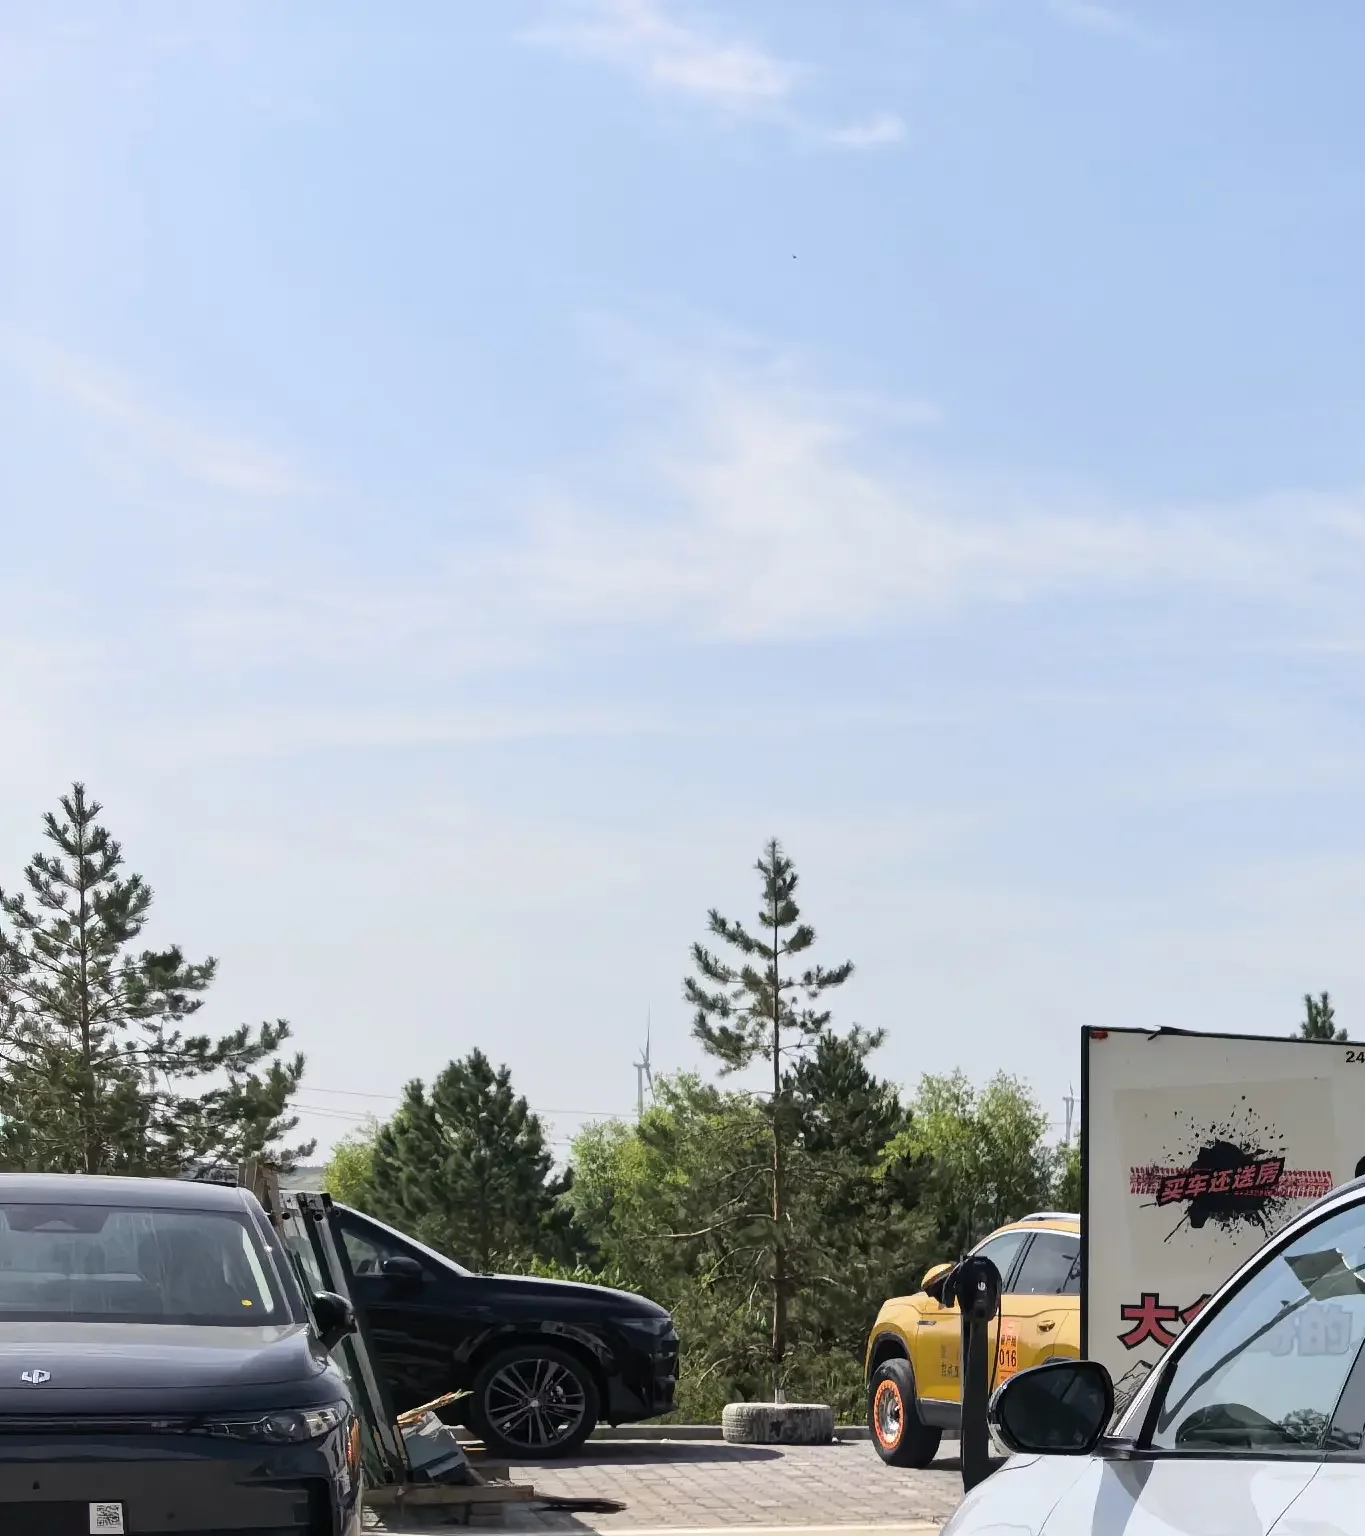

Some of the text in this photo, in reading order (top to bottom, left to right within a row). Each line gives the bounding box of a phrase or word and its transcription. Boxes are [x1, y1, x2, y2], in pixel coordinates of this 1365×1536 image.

[1161, 1160, 1282, 1203] 买车还送房
[999, 1349, 1017, 1367] 016
